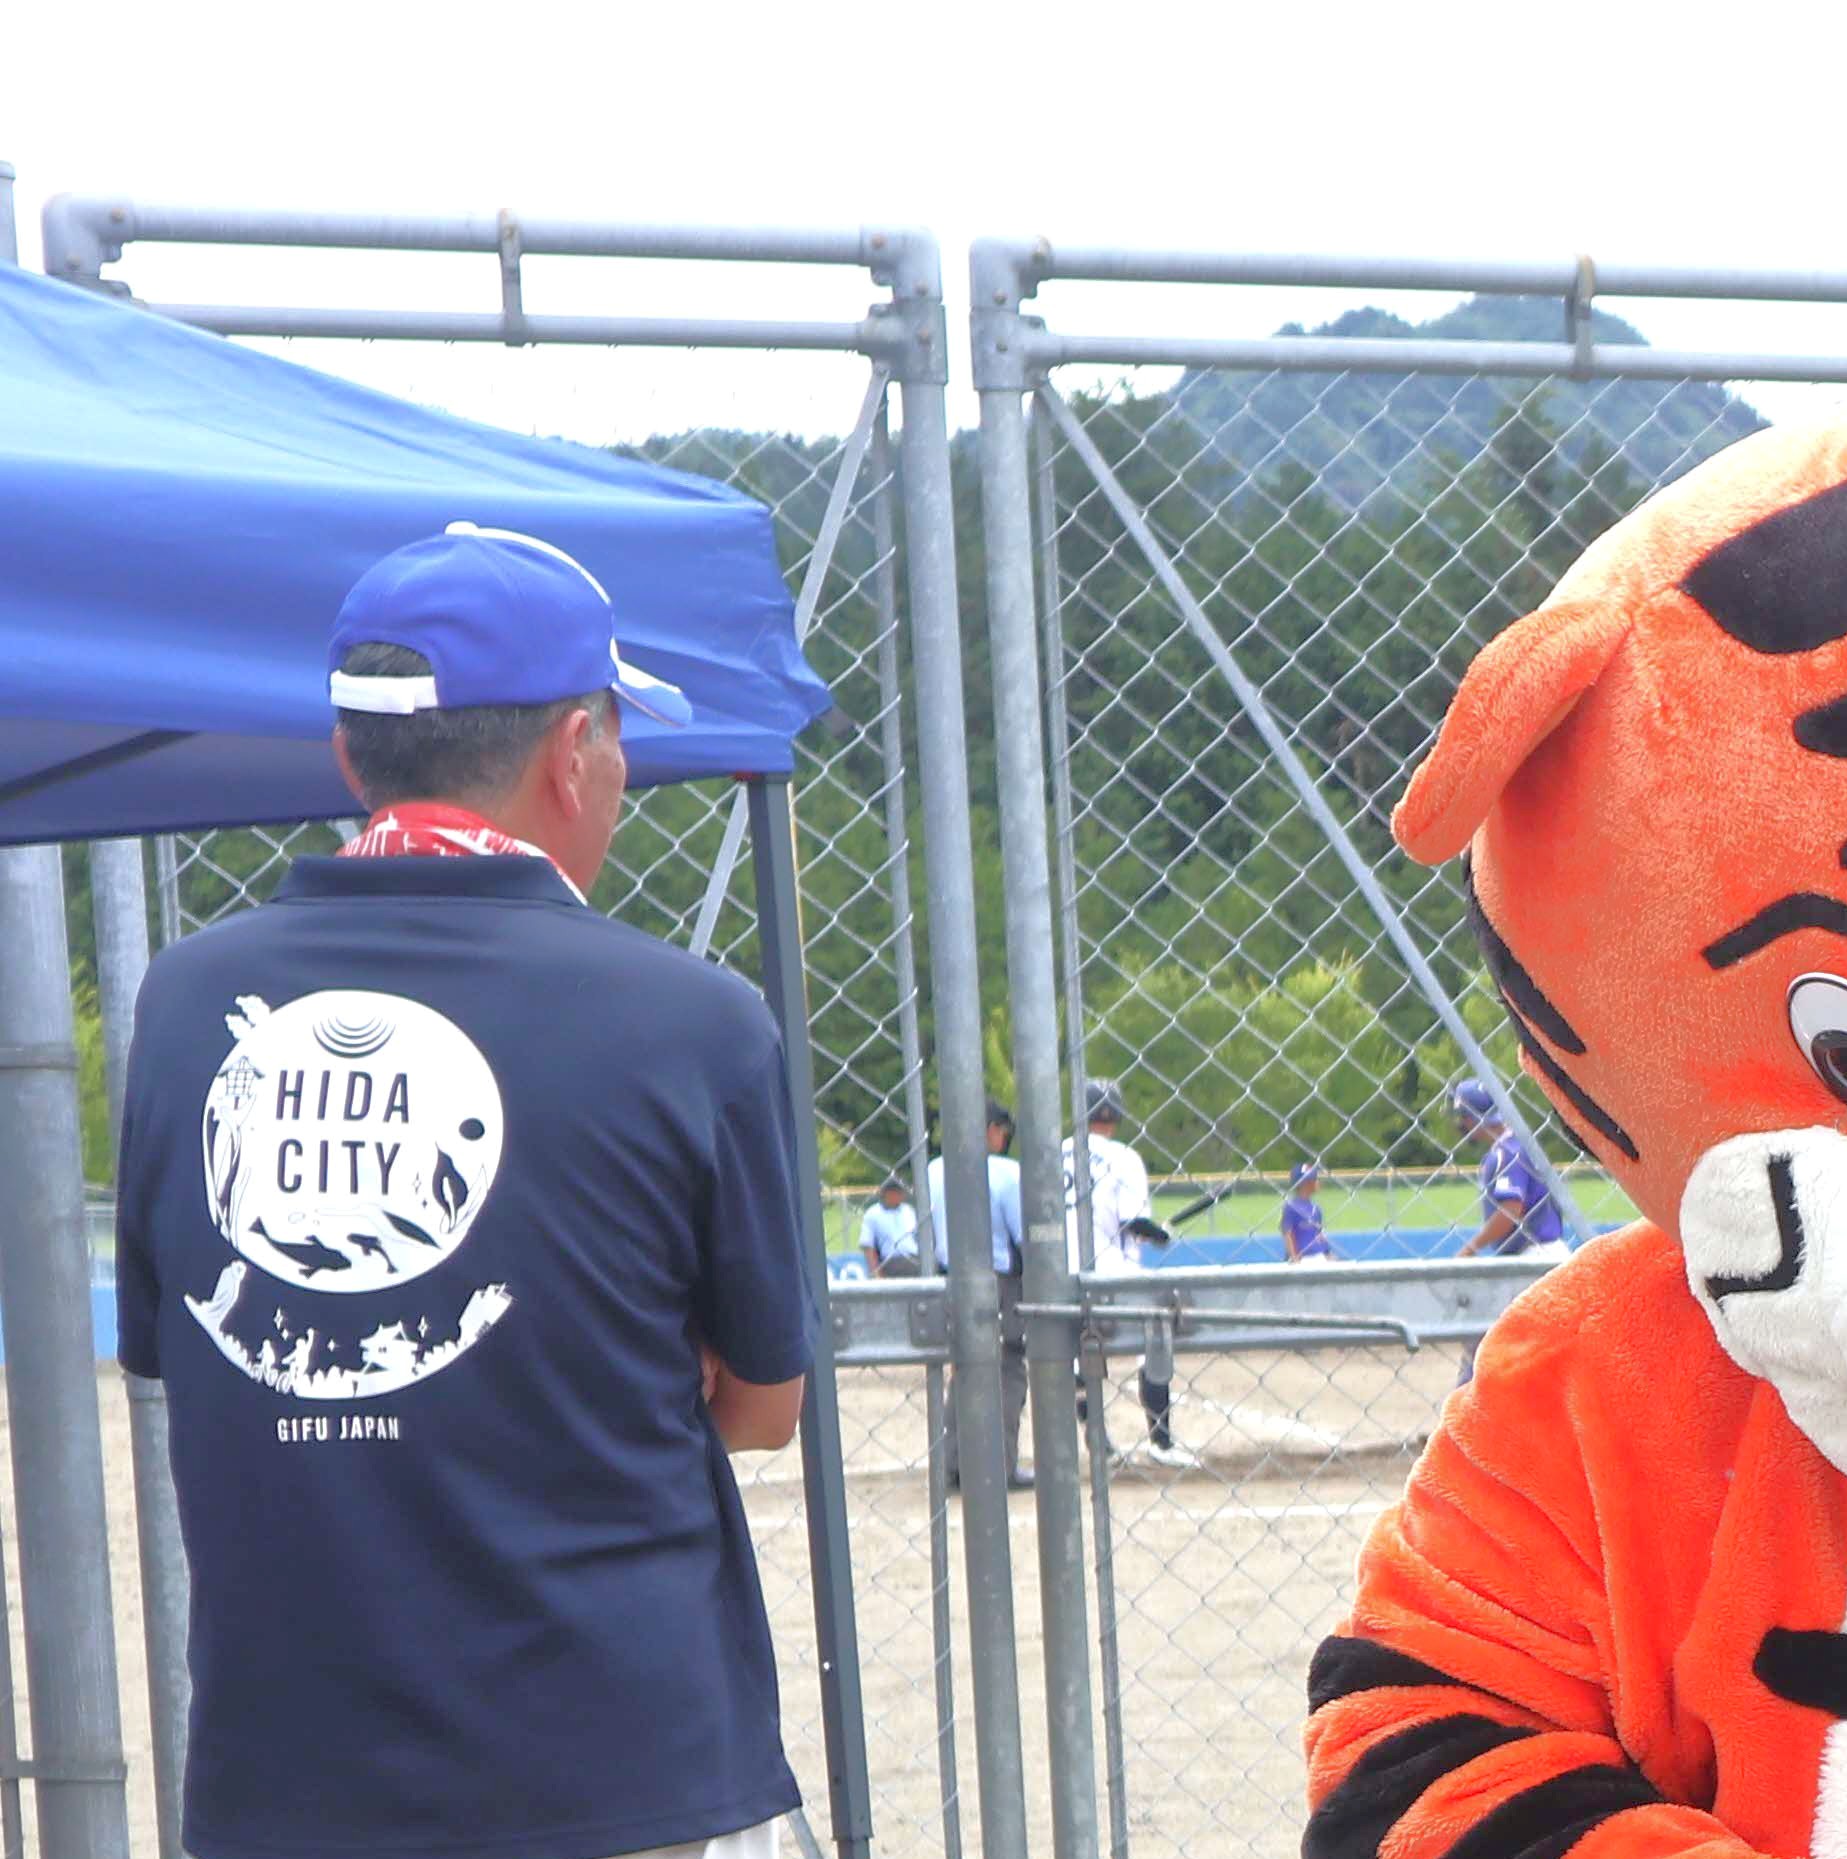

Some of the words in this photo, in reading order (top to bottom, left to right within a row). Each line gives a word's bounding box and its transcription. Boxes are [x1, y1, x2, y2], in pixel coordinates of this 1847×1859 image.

[276, 1070, 409, 1124] HIDA
[277, 1138, 401, 1195] CITY
[276, 1416, 328, 1443] GIFU
[339, 1415, 399, 1441] JAPAN
